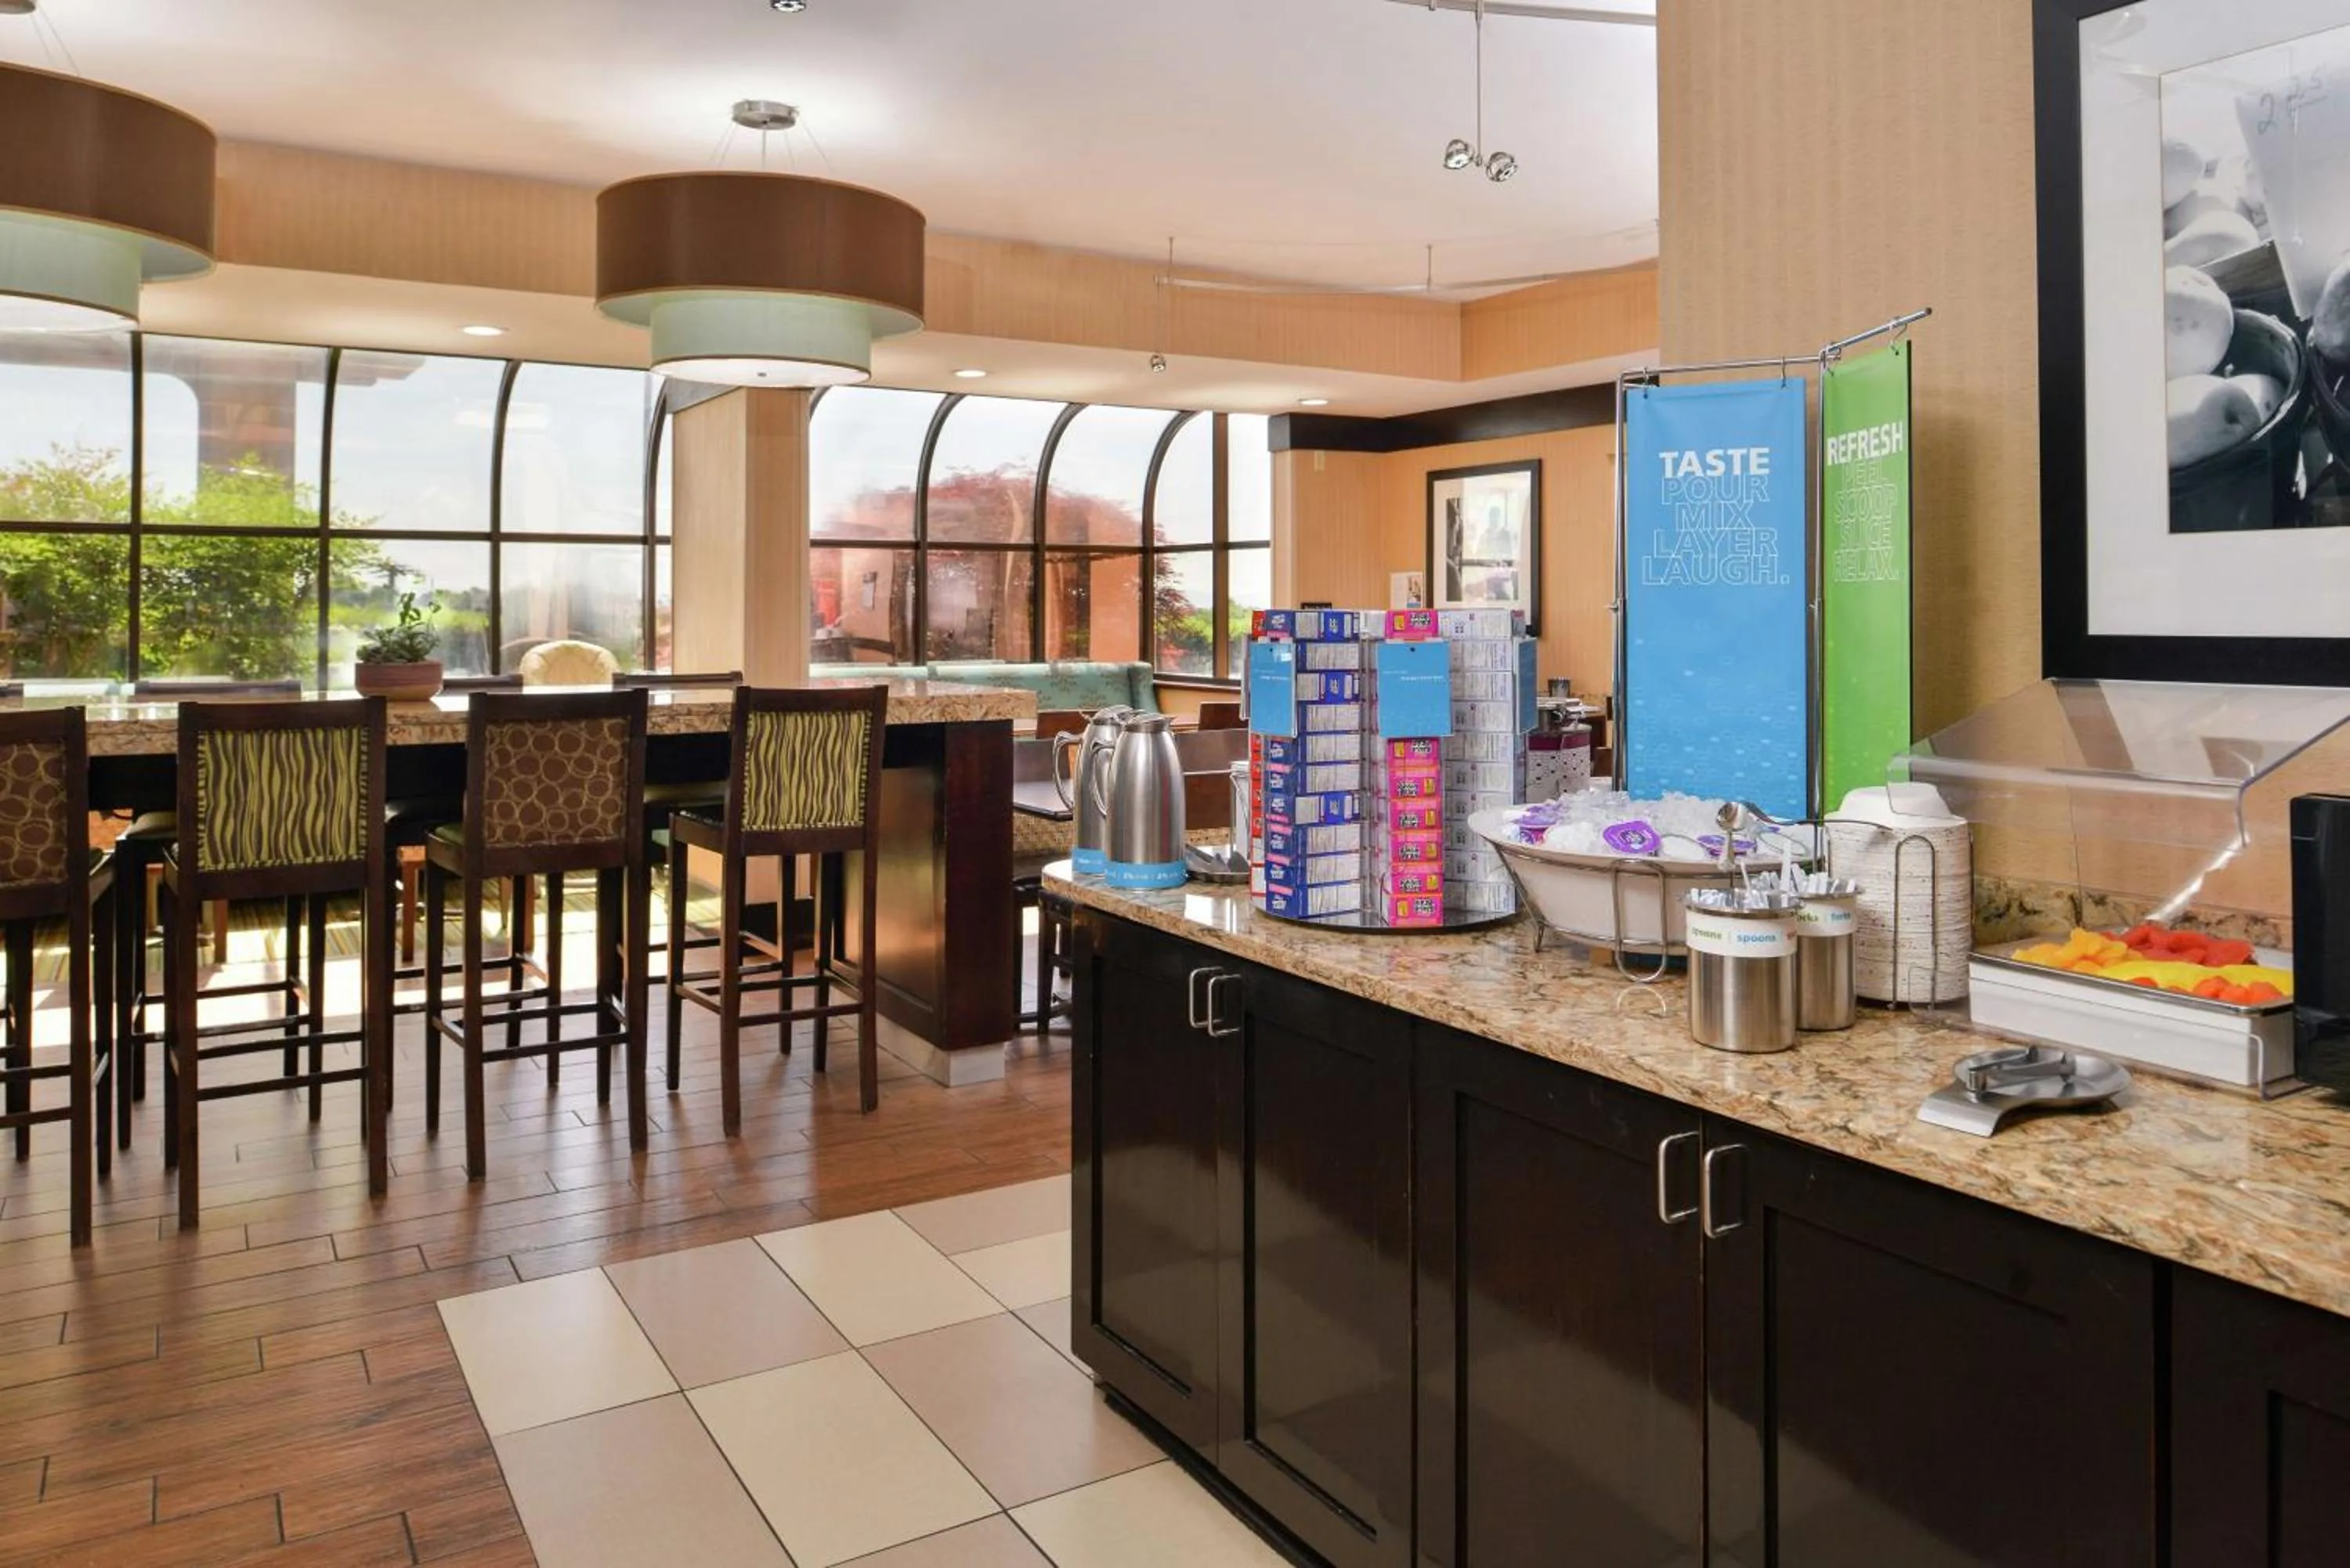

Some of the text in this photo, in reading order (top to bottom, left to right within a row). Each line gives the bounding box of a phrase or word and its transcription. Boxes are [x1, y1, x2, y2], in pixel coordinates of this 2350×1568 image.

[1827, 421, 1904, 466] REFRESH
[1658, 447, 1770, 479] TASTE
[1842, 458, 1888, 489] PEEL
[1661, 474, 1770, 505] POUR
[1835, 484, 1898, 523] SCOOP
[1676, 501, 1754, 532] MIX
[1654, 528, 1779, 558] LAYER
[1840, 518, 1893, 550] SLICE
[1643, 555, 1791, 585] LAUGH.
[1834, 546, 1900, 583] RELAX.
[1737, 932, 1777, 945] spoons
